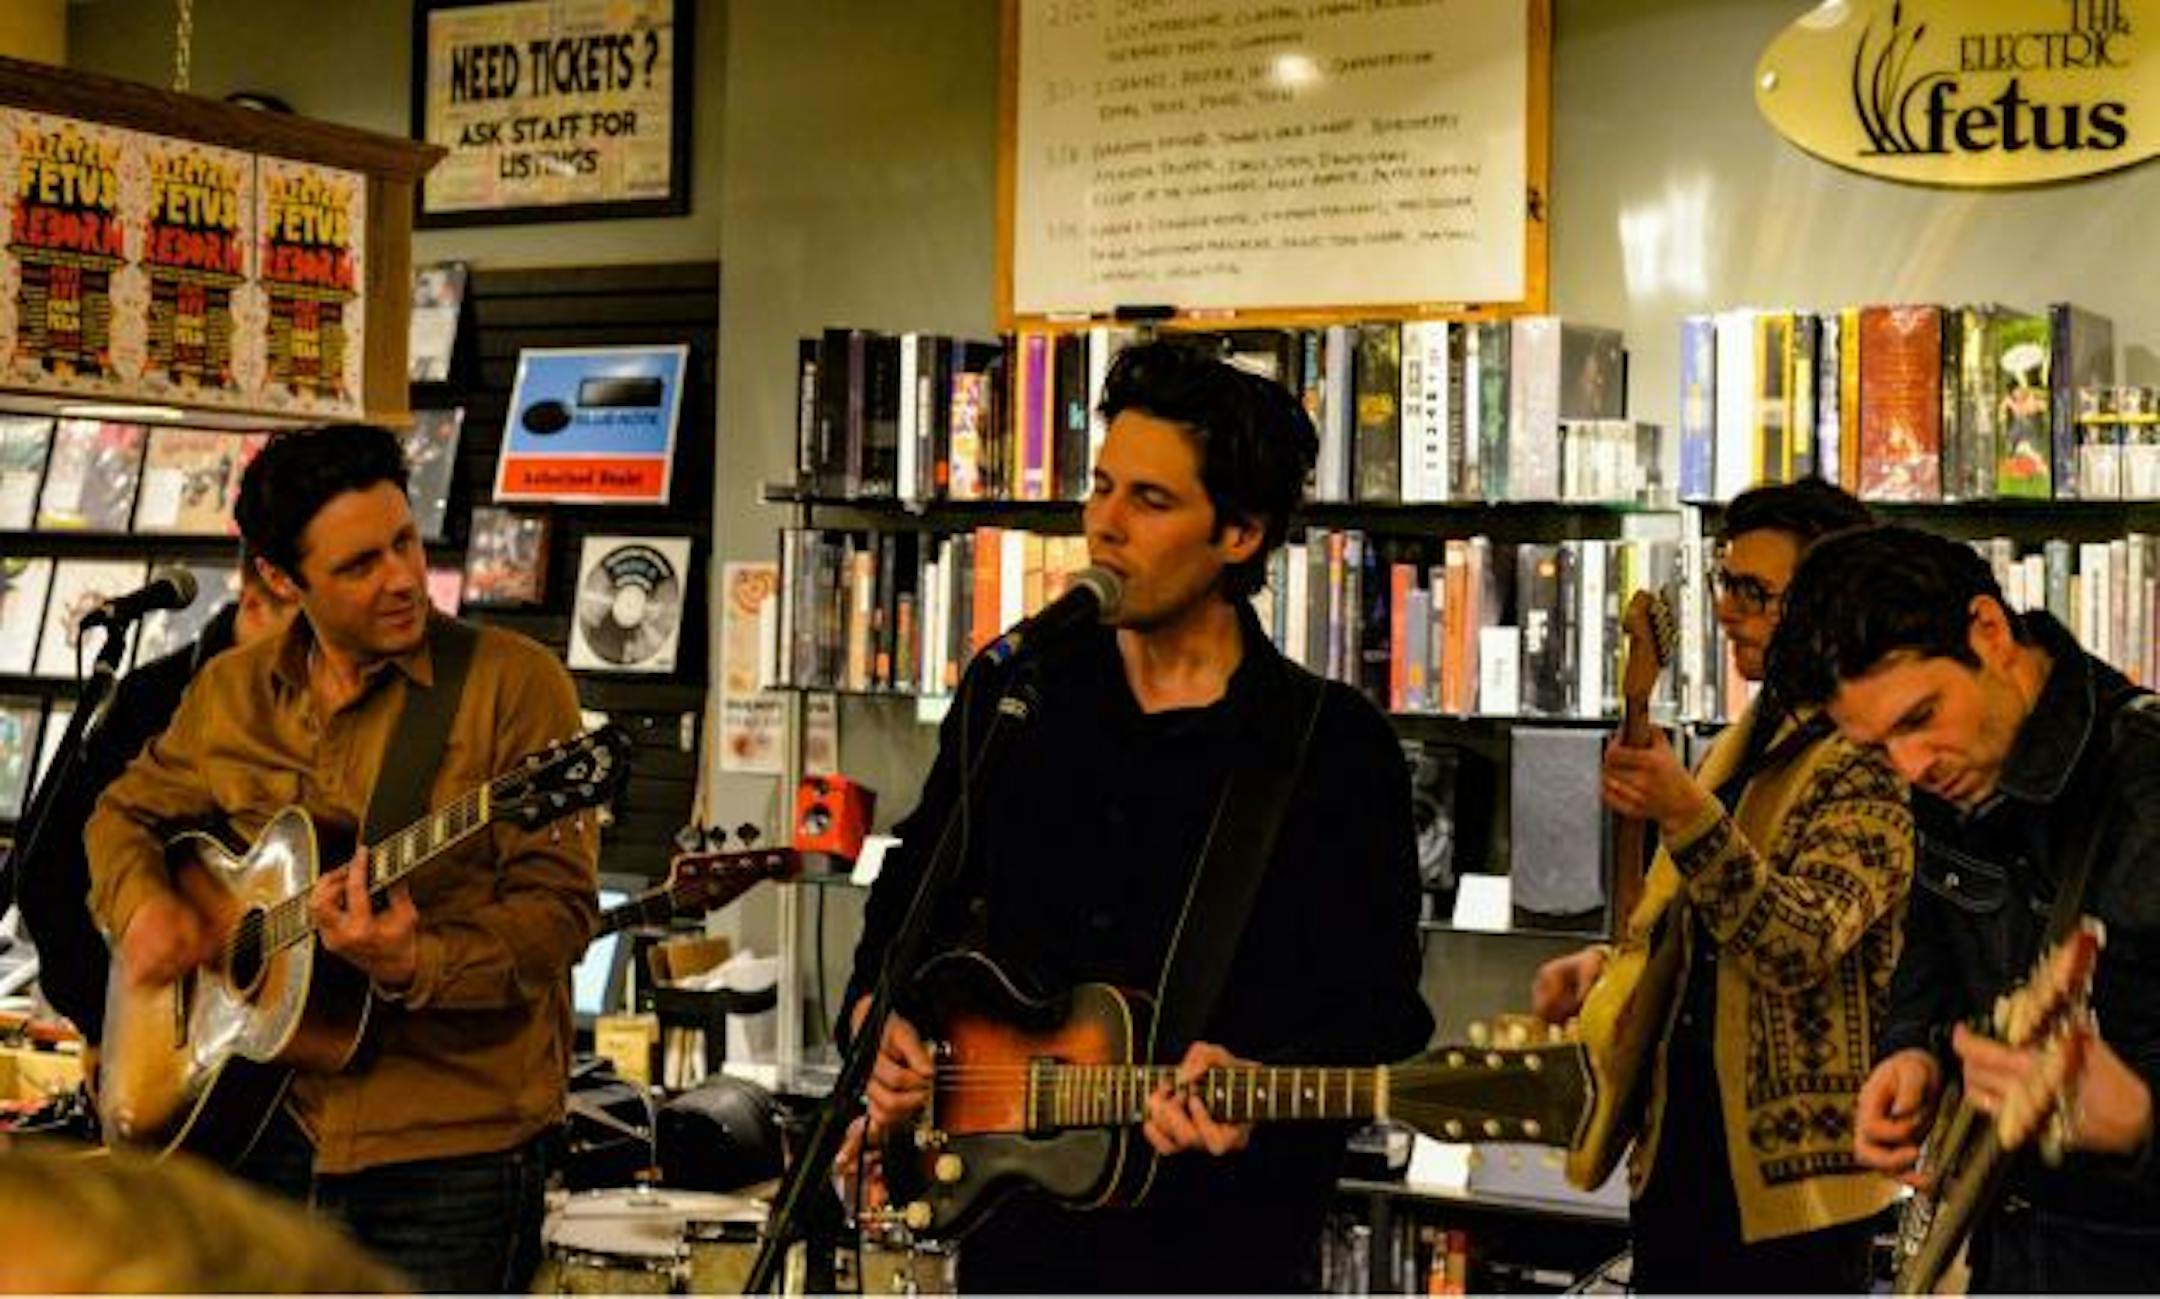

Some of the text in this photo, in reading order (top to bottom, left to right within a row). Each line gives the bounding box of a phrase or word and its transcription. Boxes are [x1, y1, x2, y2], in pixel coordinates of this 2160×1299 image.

[2066, 0, 2129, 33] THE
[452, 29, 658, 104] NEED TICKETS ?
[1959, 33, 2129, 71] ELECTRIC
[459, 111, 637, 147] ASK STAFF FOR
[1924, 78, 2127, 154] fetus
[19, 159, 117, 208] FETUS
[149, 181, 237, 229] FETUS
[267, 201, 348, 248] FETUS
